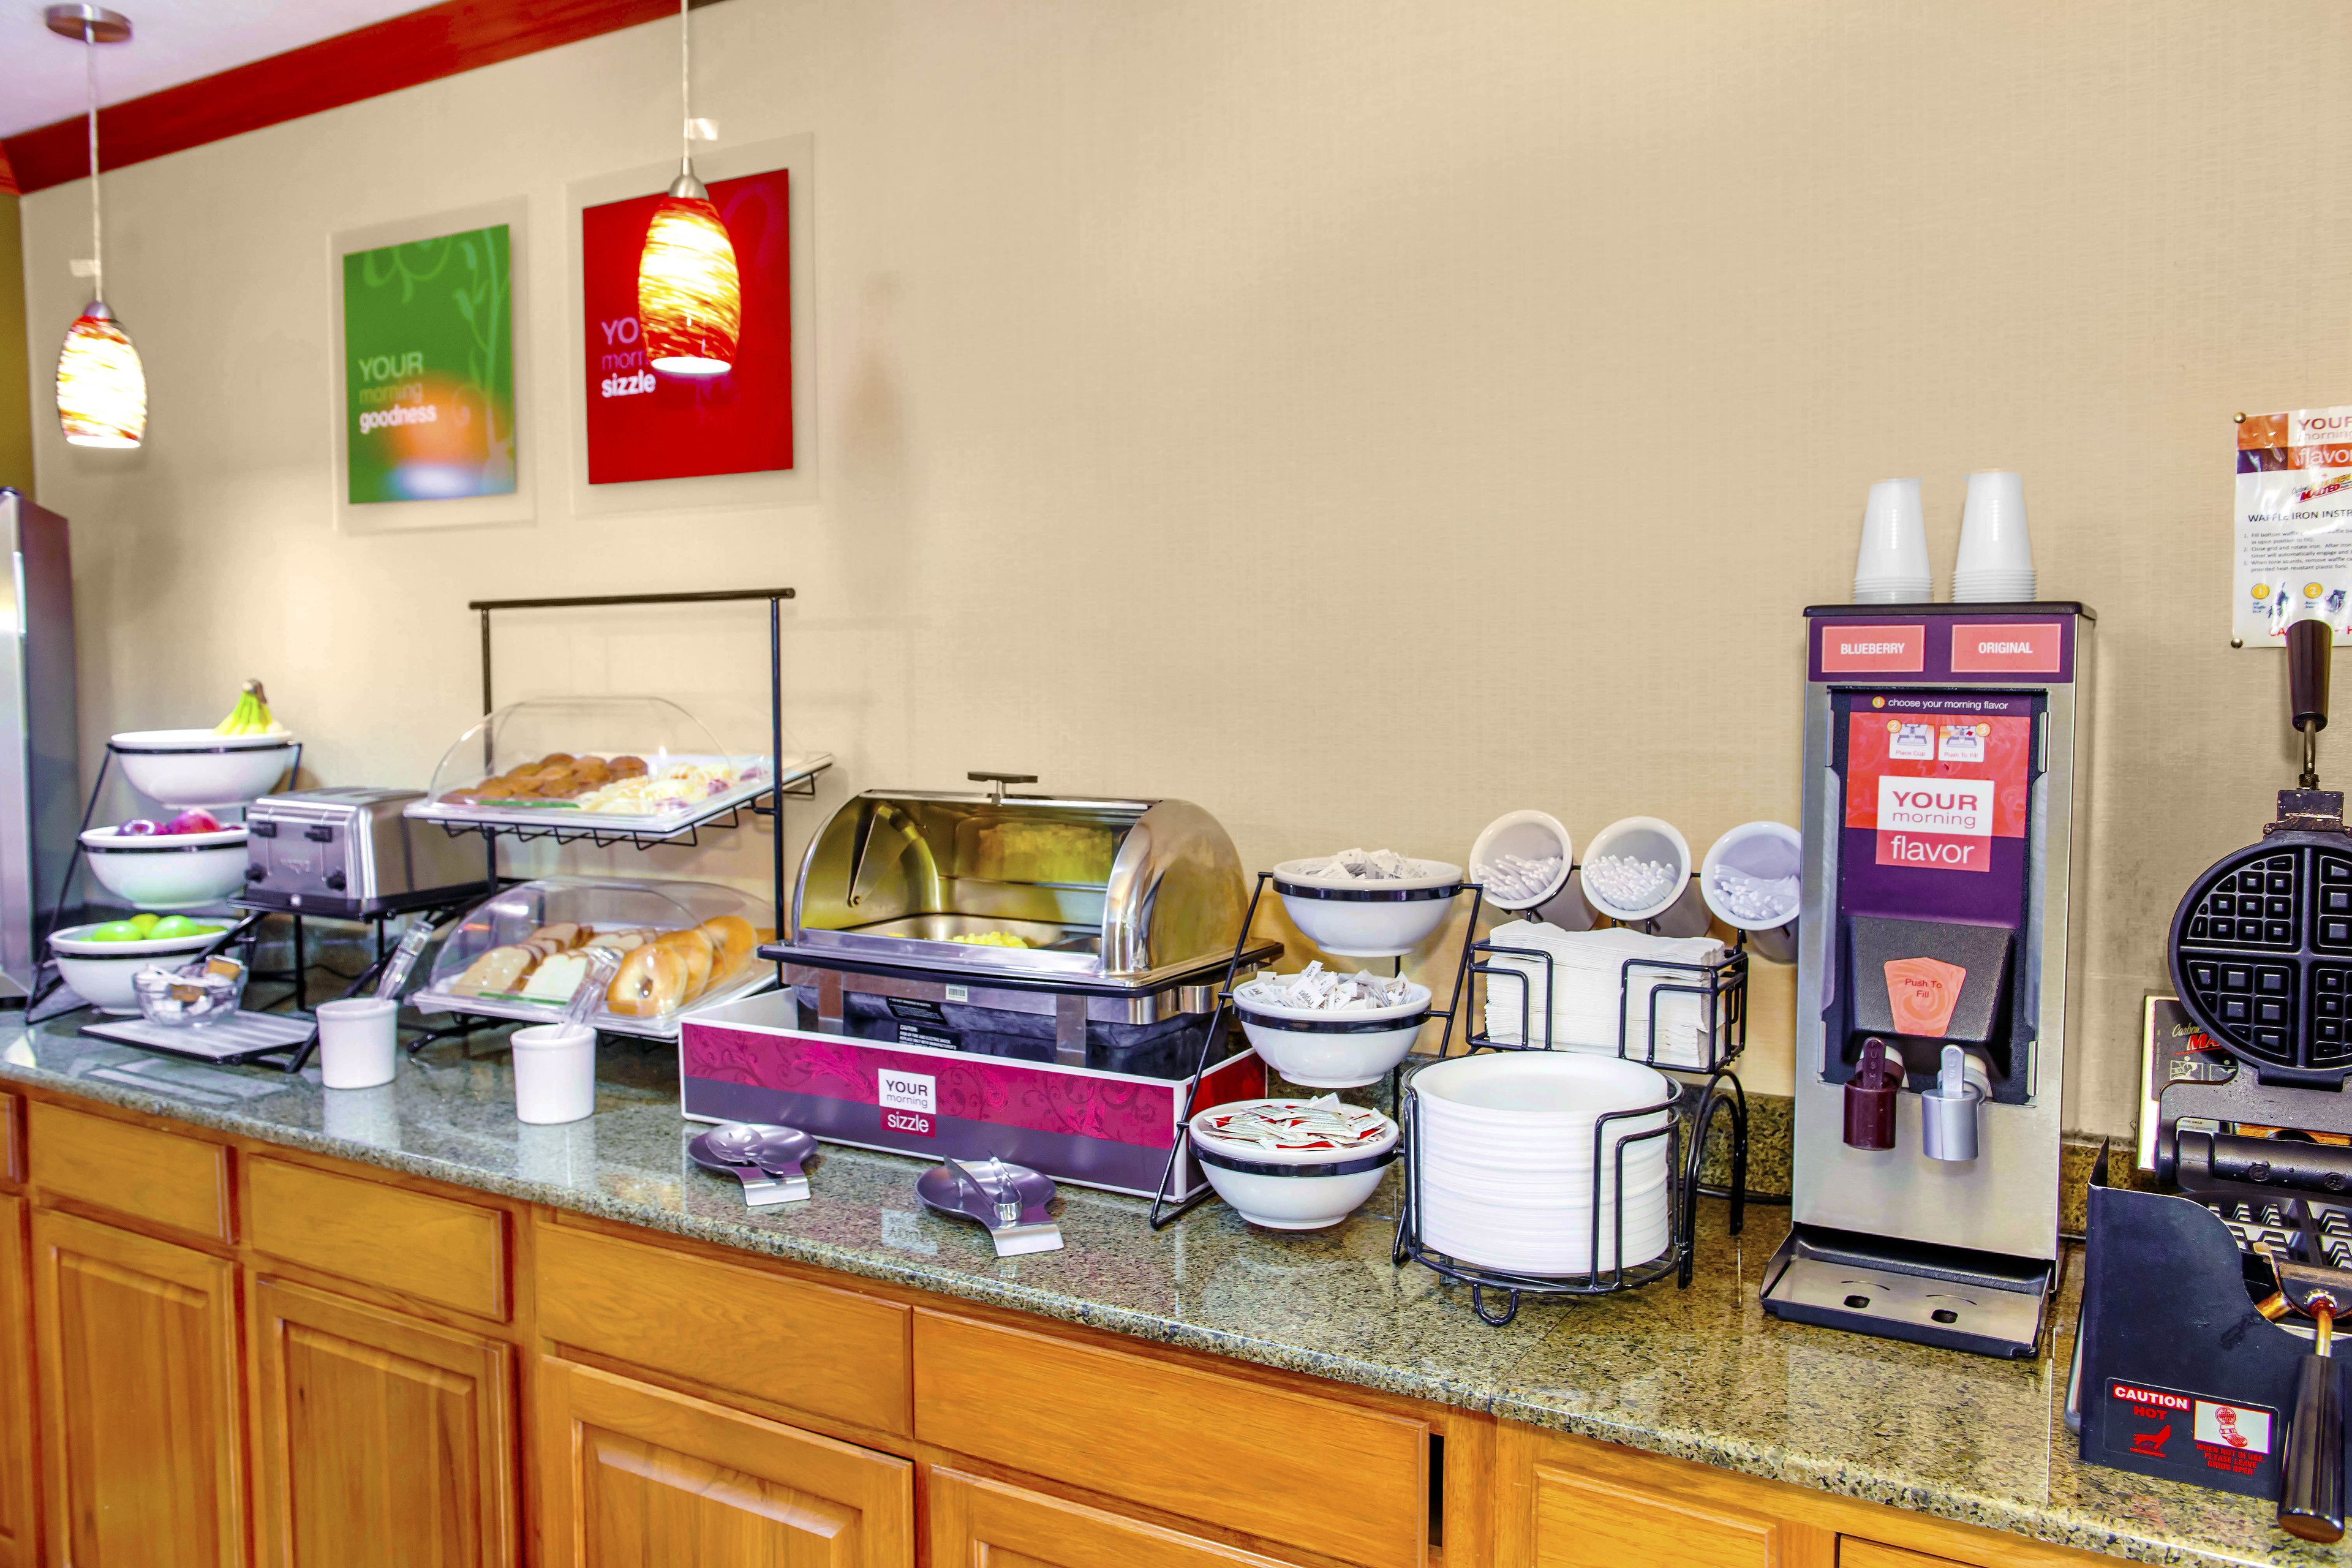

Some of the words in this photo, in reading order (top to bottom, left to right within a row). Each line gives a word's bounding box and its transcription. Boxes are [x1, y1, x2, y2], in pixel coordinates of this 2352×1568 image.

[601, 317, 639, 346] YO
[358, 352, 423, 382] YOUR
[601, 350, 649, 371] morn
[601, 369, 656, 398] sizzle
[359, 383, 422, 404] morning
[360, 404, 437, 434] goodness
[2292, 511, 2318, 520] IRON
[1841, 643, 1905, 655] BLUEBERRY
[1978, 642, 2033, 654] ORIGINAL
[1888, 698, 1921, 708] choose
[1923, 701, 1943, 710] your
[1944, 700, 1981, 711] morning
[1984, 701, 2008, 710] flavor
[1892, 791, 1978, 812] YOUR
[1892, 811, 1977, 829] morning
[1891, 835, 1975, 864] flavor
[1905, 978, 1928, 988] Push
[1931, 980, 1942, 989] To
[1916, 990, 1930, 999] Fill
[886, 1079, 928, 1096] YOUR
[886, 1094, 928, 1109] morning
[887, 1111, 929, 1133] sizzle
[2114, 1387, 2189, 1409] CAUTION
[2133, 1405, 2168, 1420] HOT
[2196, 1442, 2219, 1453] WHEN
[2220, 1448, 2236, 1457] NOT
[2204, 1452, 2232, 1464] PLEASE
[2234, 1457, 2257, 1469] LEAVE
[2207, 1460, 2231, 1471] GRIDS
[2233, 1465, 2254, 1475] OPEN
